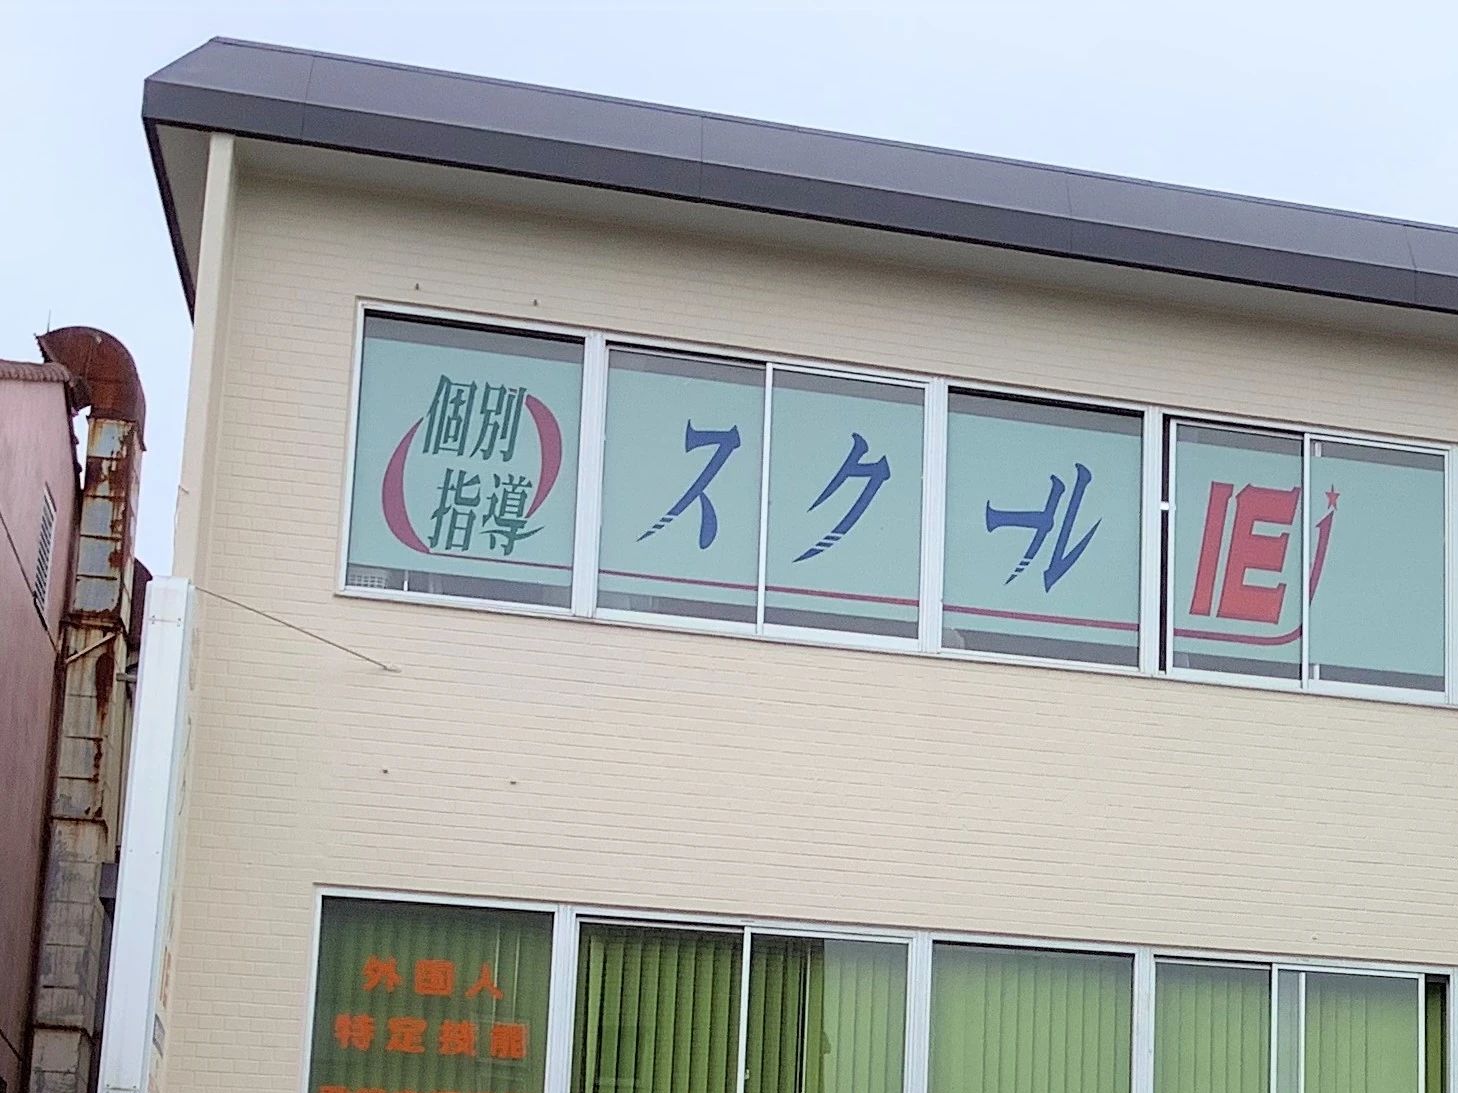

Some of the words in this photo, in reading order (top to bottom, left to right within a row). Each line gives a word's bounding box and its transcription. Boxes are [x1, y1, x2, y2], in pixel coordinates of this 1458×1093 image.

[422, 374, 528, 463] 個別
[427, 467, 544, 556] 指導
[635, 417, 1102, 594] スクール
[1191, 480, 1301, 624] IE
[362, 955, 503, 999] 外国人
